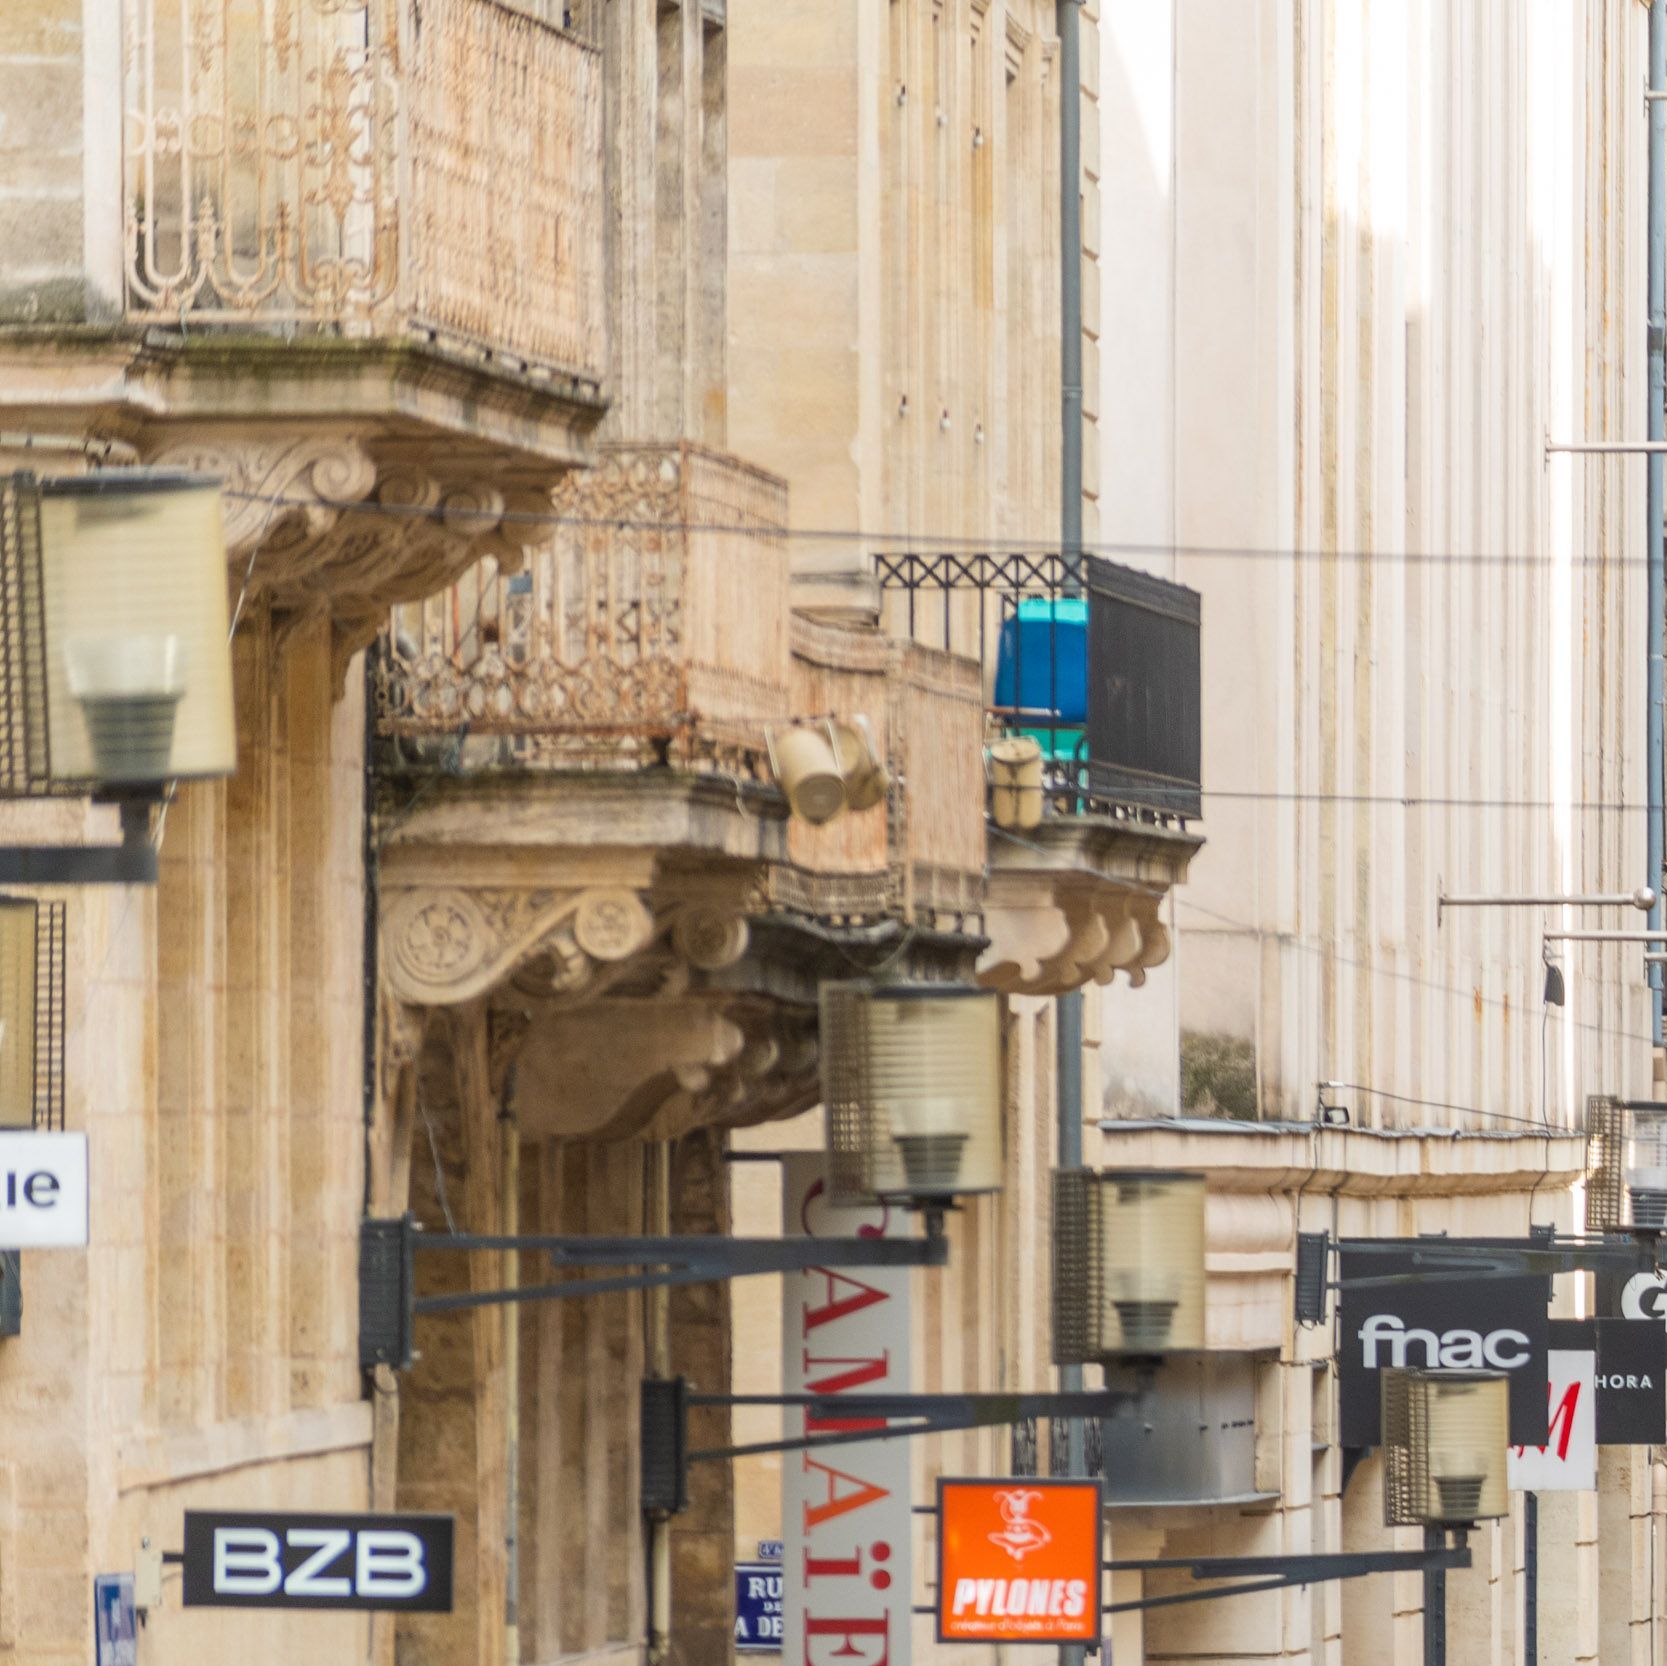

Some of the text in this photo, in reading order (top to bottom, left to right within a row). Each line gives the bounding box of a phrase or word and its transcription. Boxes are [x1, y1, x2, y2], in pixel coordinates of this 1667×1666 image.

[1357, 1314, 1532, 1369] fnac
[213, 1528, 431, 1599] BZB
[748, 1576, 784, 1599] RU
[952, 1578, 1088, 1618] PYLONES
